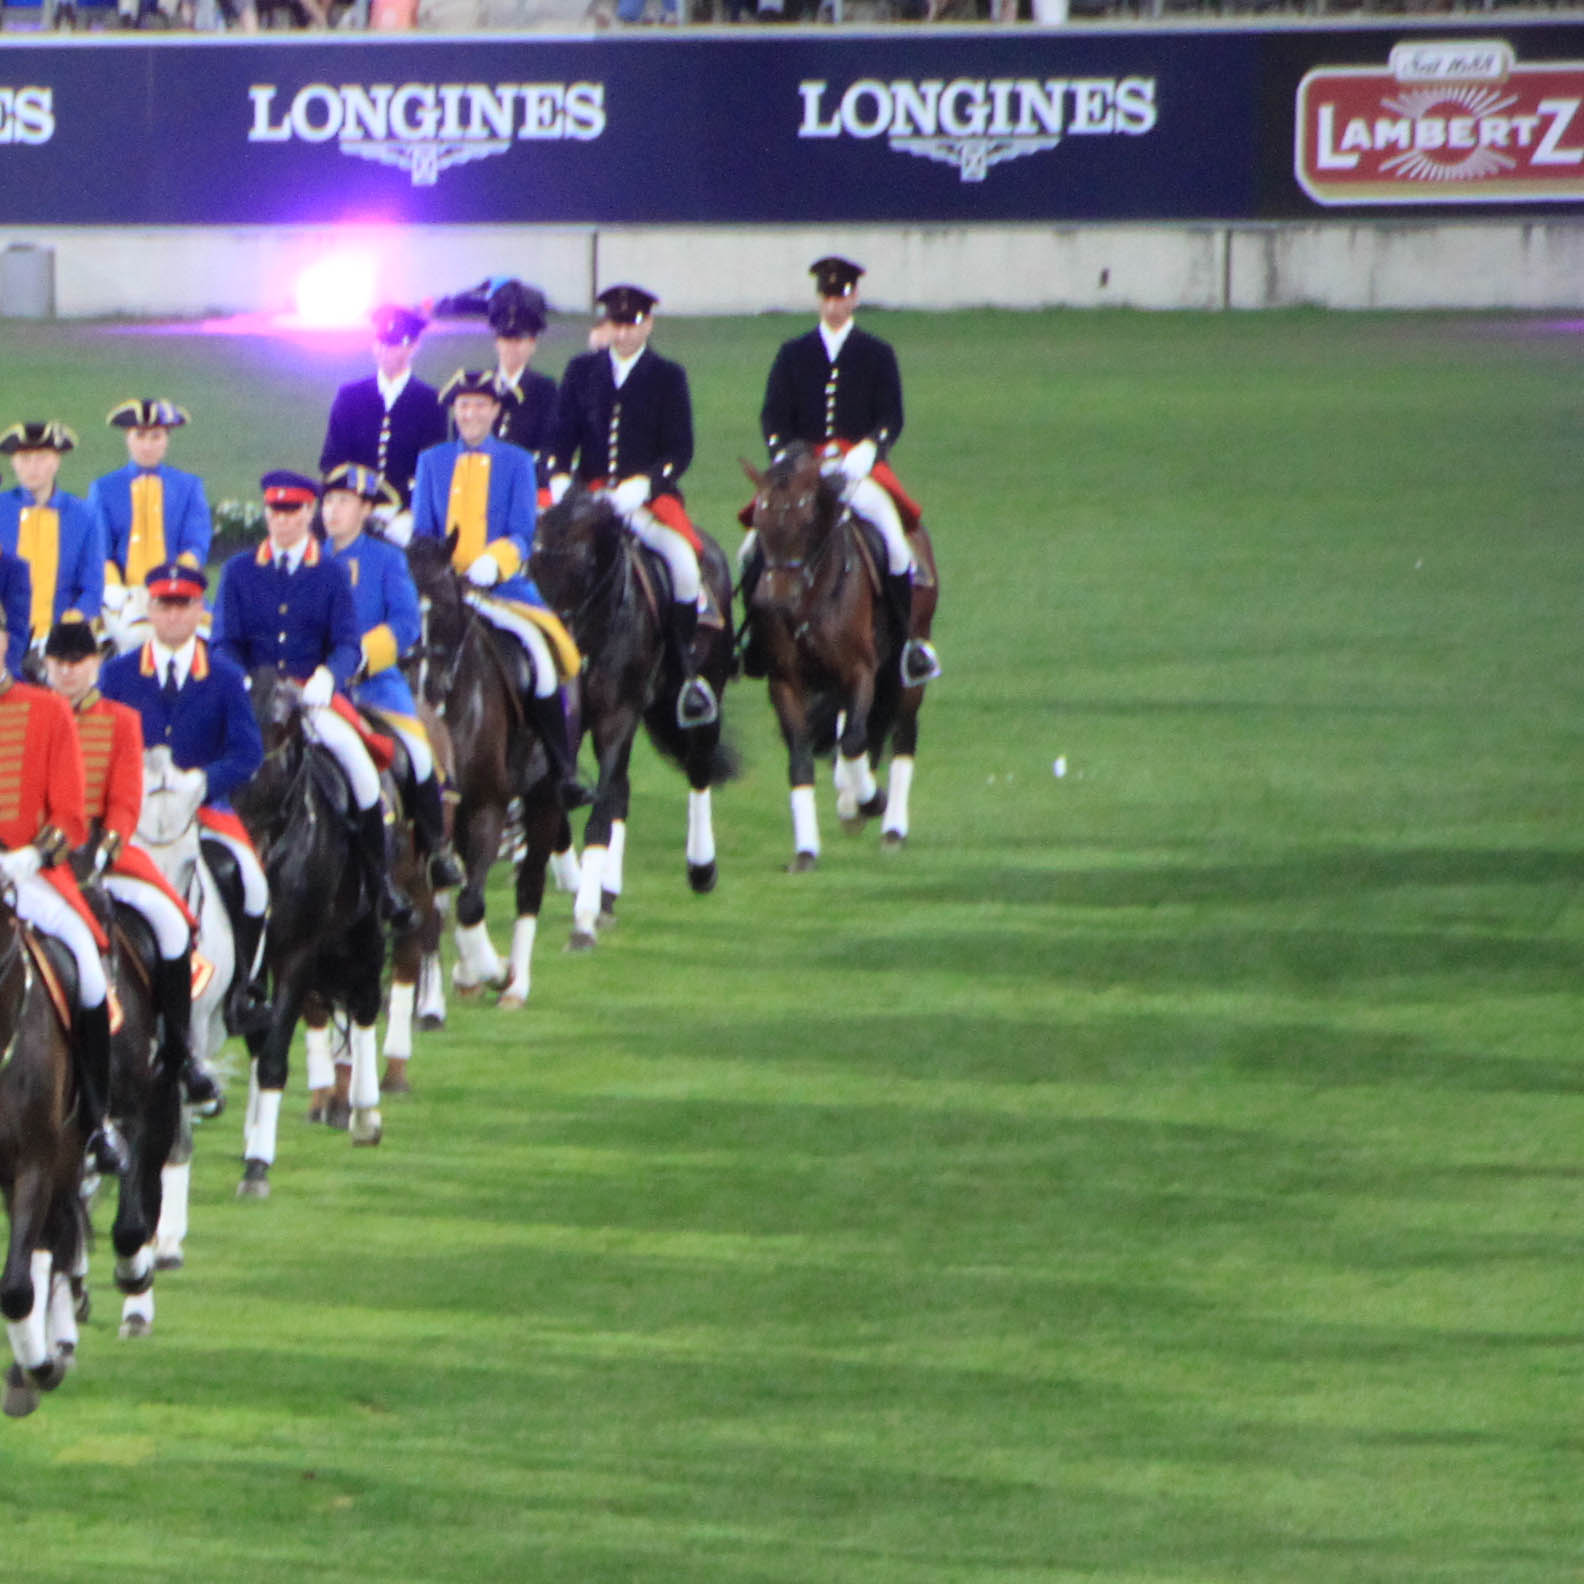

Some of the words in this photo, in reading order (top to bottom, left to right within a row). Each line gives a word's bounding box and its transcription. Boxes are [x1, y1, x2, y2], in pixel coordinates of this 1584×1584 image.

[248, 82, 606, 141] LONGINES
[798, 77, 1157, 138] LONGINES
[1316, 98, 1584, 169] LAMBERTZ
